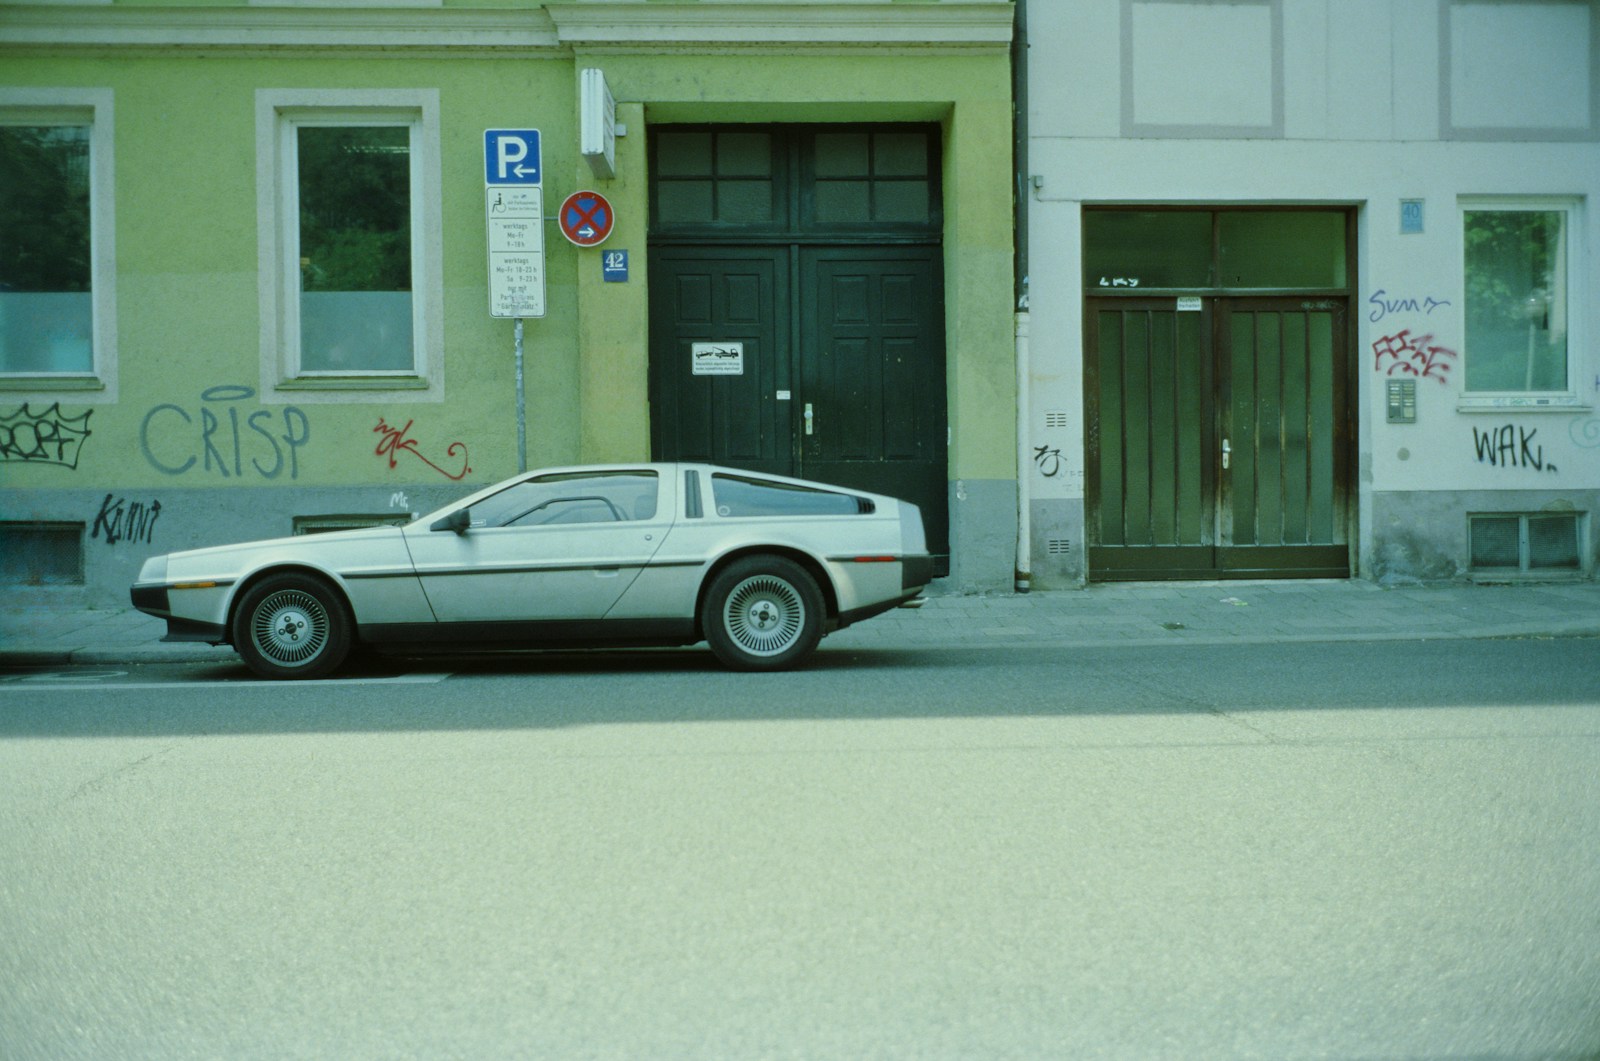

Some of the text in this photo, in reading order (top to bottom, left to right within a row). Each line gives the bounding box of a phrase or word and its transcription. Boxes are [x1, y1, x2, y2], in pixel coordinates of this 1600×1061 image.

[497, 136, 528, 178] P
[1403, 204, 1420, 219] 40
[503, 223, 528, 231] werktags
[605, 252, 624, 268] 42
[139, 403, 310, 480] CRISP
